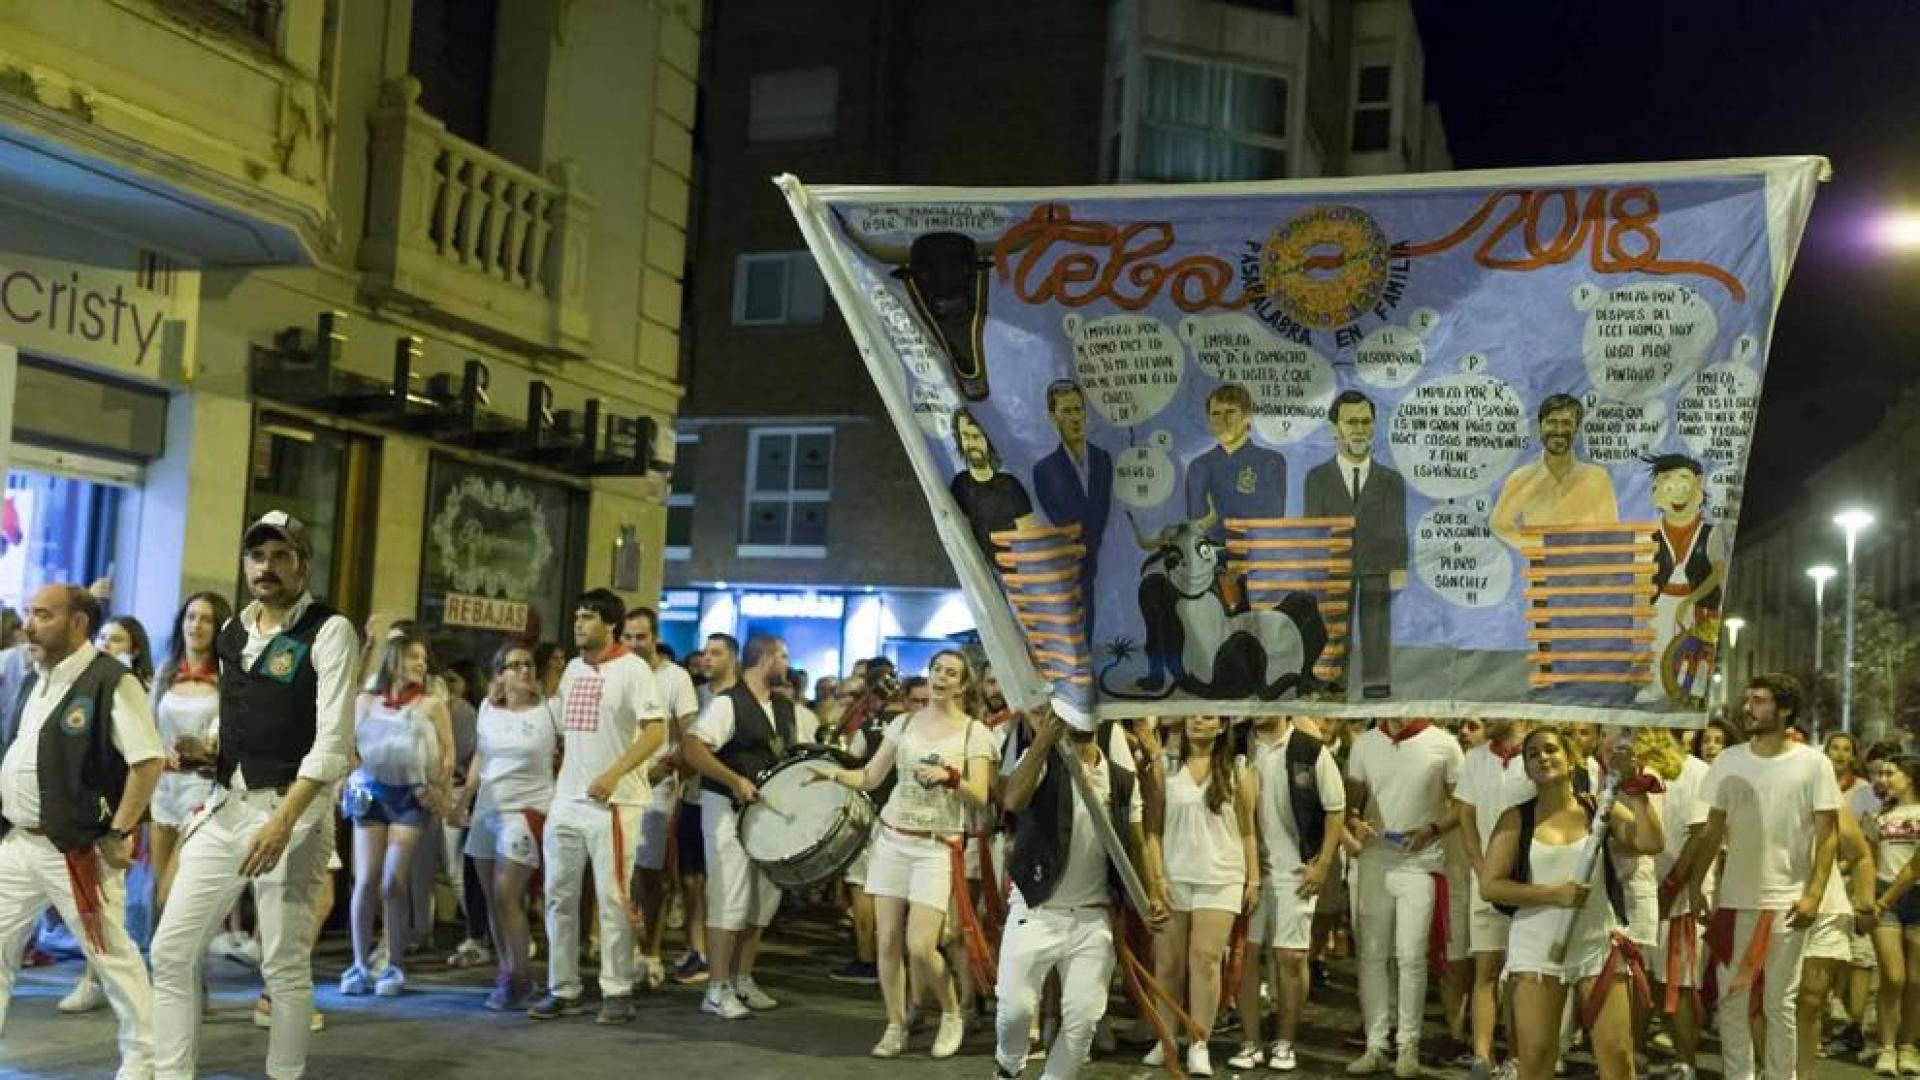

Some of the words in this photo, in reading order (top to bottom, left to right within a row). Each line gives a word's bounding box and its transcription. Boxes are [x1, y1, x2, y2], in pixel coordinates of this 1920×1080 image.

[1475, 187, 1661, 275] 2018
[1335, 322, 1365, 349] EN
[1373, 239, 1411, 321] FAMILIA
[1741, 339, 1750, 353] P
[1468, 355, 1480, 370] P
[1465, 385, 1488, 400] POR
[1440, 556, 1477, 571] PEDRO
[446, 598, 527, 630] REBAJAS
